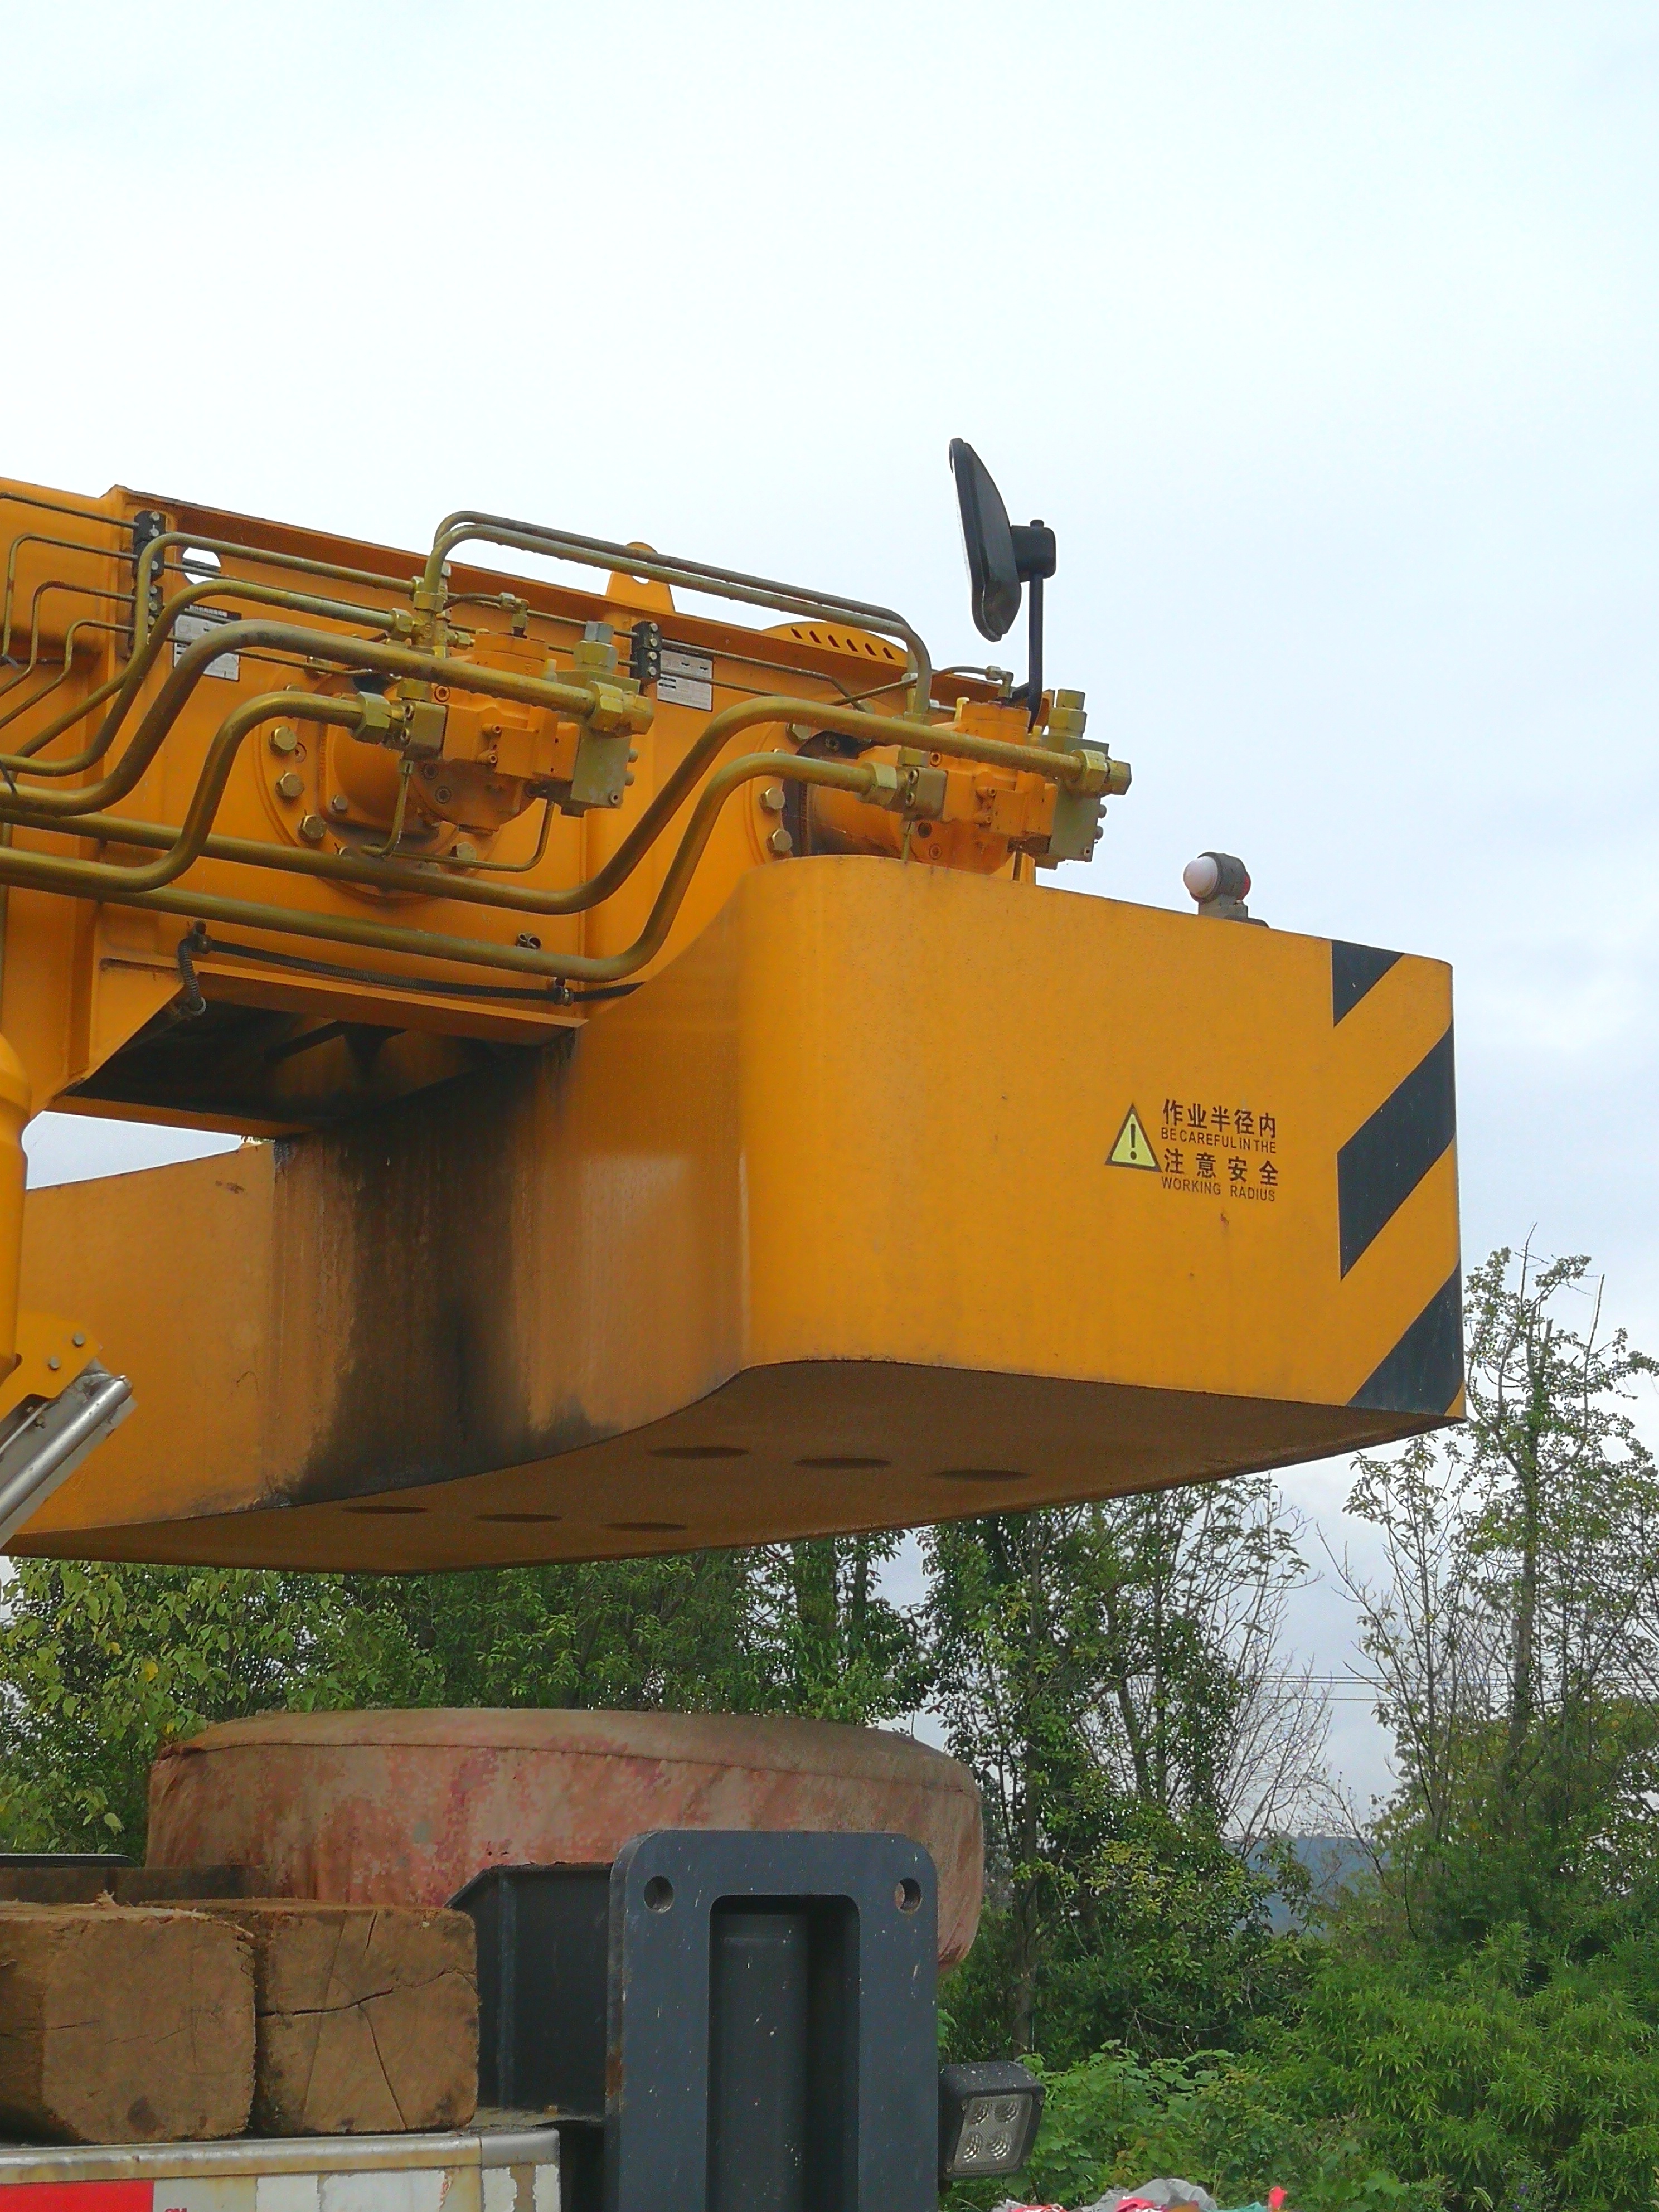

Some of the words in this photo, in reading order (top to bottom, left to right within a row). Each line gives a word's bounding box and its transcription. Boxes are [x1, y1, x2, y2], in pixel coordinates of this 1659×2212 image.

[1163, 1098, 1276, 1138] 作业半径内
[1161, 1127, 1176, 1141] BE
[1180, 1129, 1237, 1148] CAREFUL
[1239, 1137, 1251, 1151] IN
[1254, 1139, 1277, 1153] THE
[1163, 1148, 1279, 1186] 注意安全
[1161, 1177, 1221, 1195] WORKING
[1230, 1185, 1276, 1202] RADIUS
